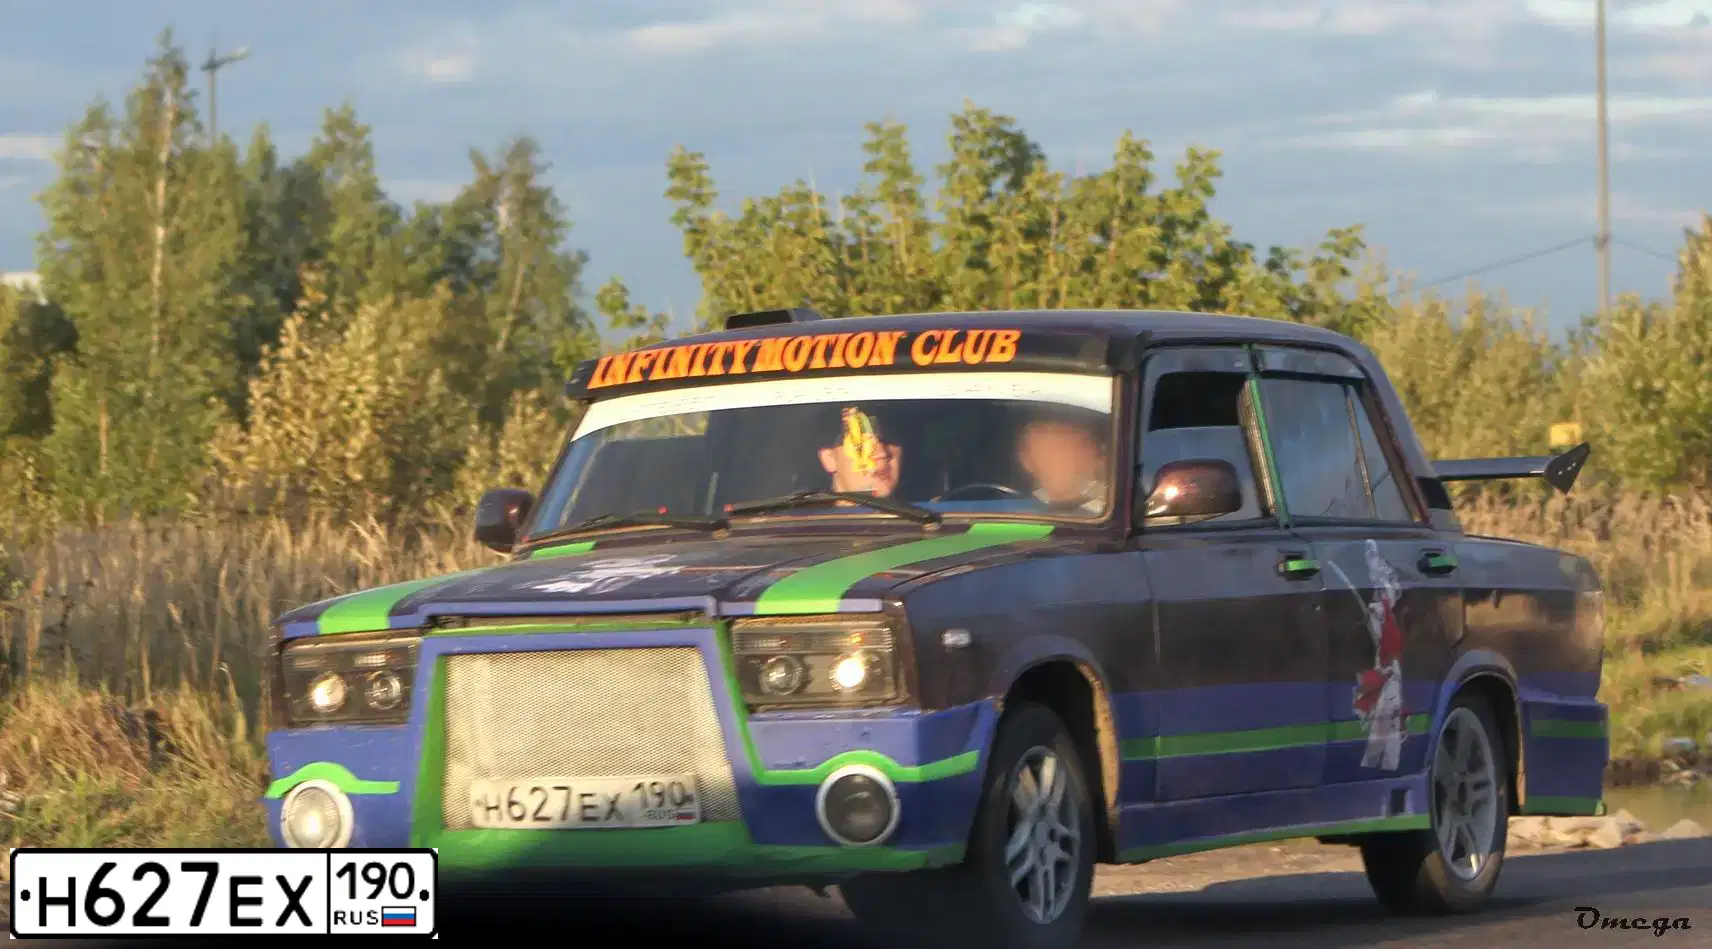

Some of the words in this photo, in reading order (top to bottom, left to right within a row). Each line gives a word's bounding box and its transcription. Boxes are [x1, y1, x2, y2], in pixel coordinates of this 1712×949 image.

[587, 339, 759, 389] INFINITY
[753, 331, 908, 372] MOTION
[910, 329, 1022, 365] CLUB
